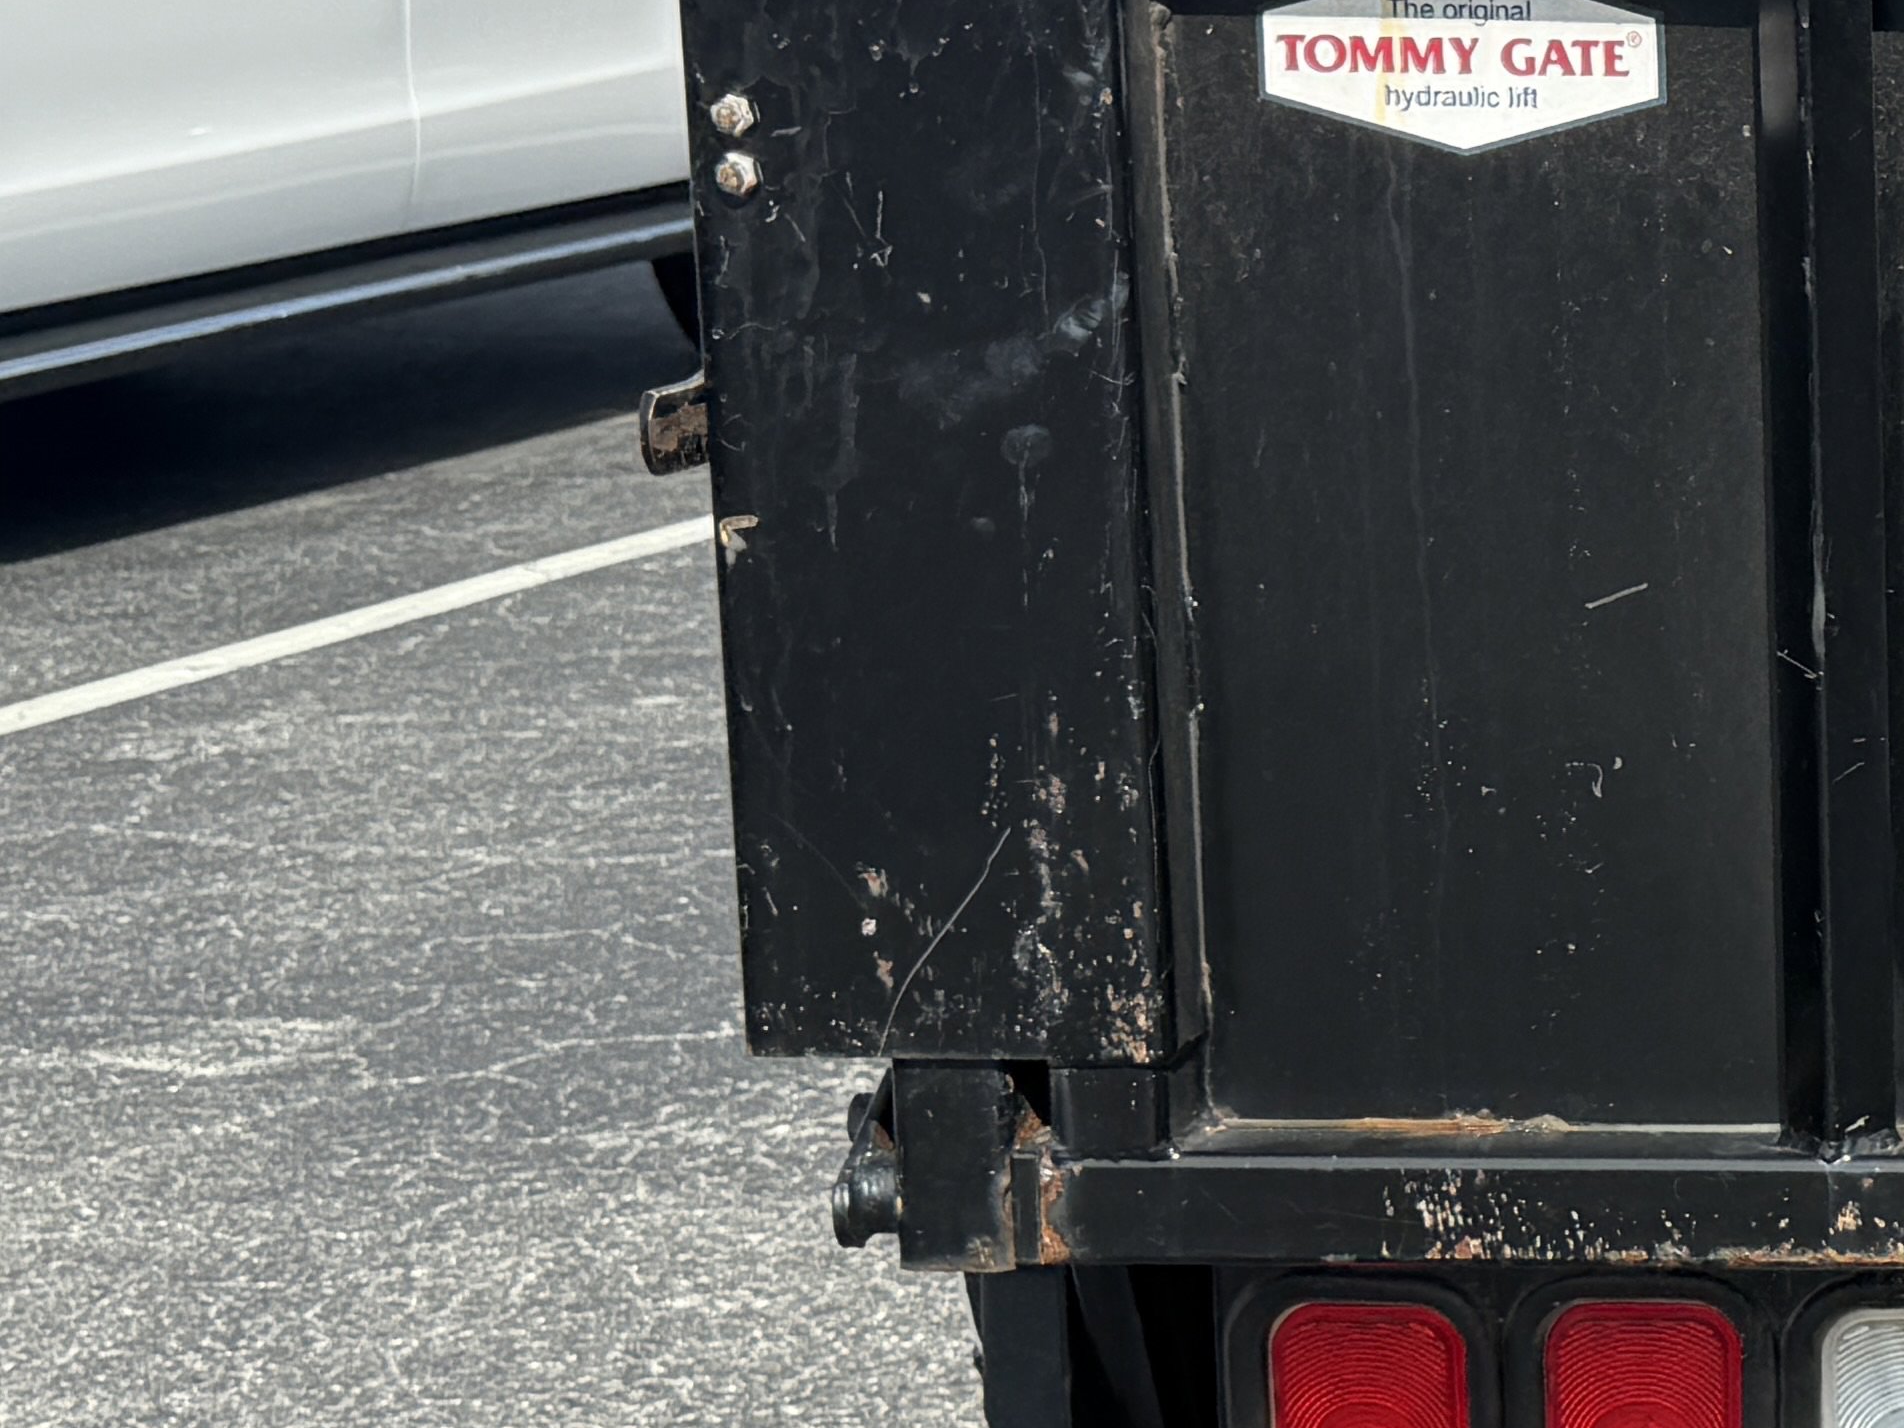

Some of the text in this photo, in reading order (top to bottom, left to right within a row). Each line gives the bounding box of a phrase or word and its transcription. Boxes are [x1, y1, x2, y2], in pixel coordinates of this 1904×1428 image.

[1442, 0, 1532, 27] original
[1276, 34, 1479, 74] TOMMY
[1385, 85, 1539, 112] hydraulic lift
